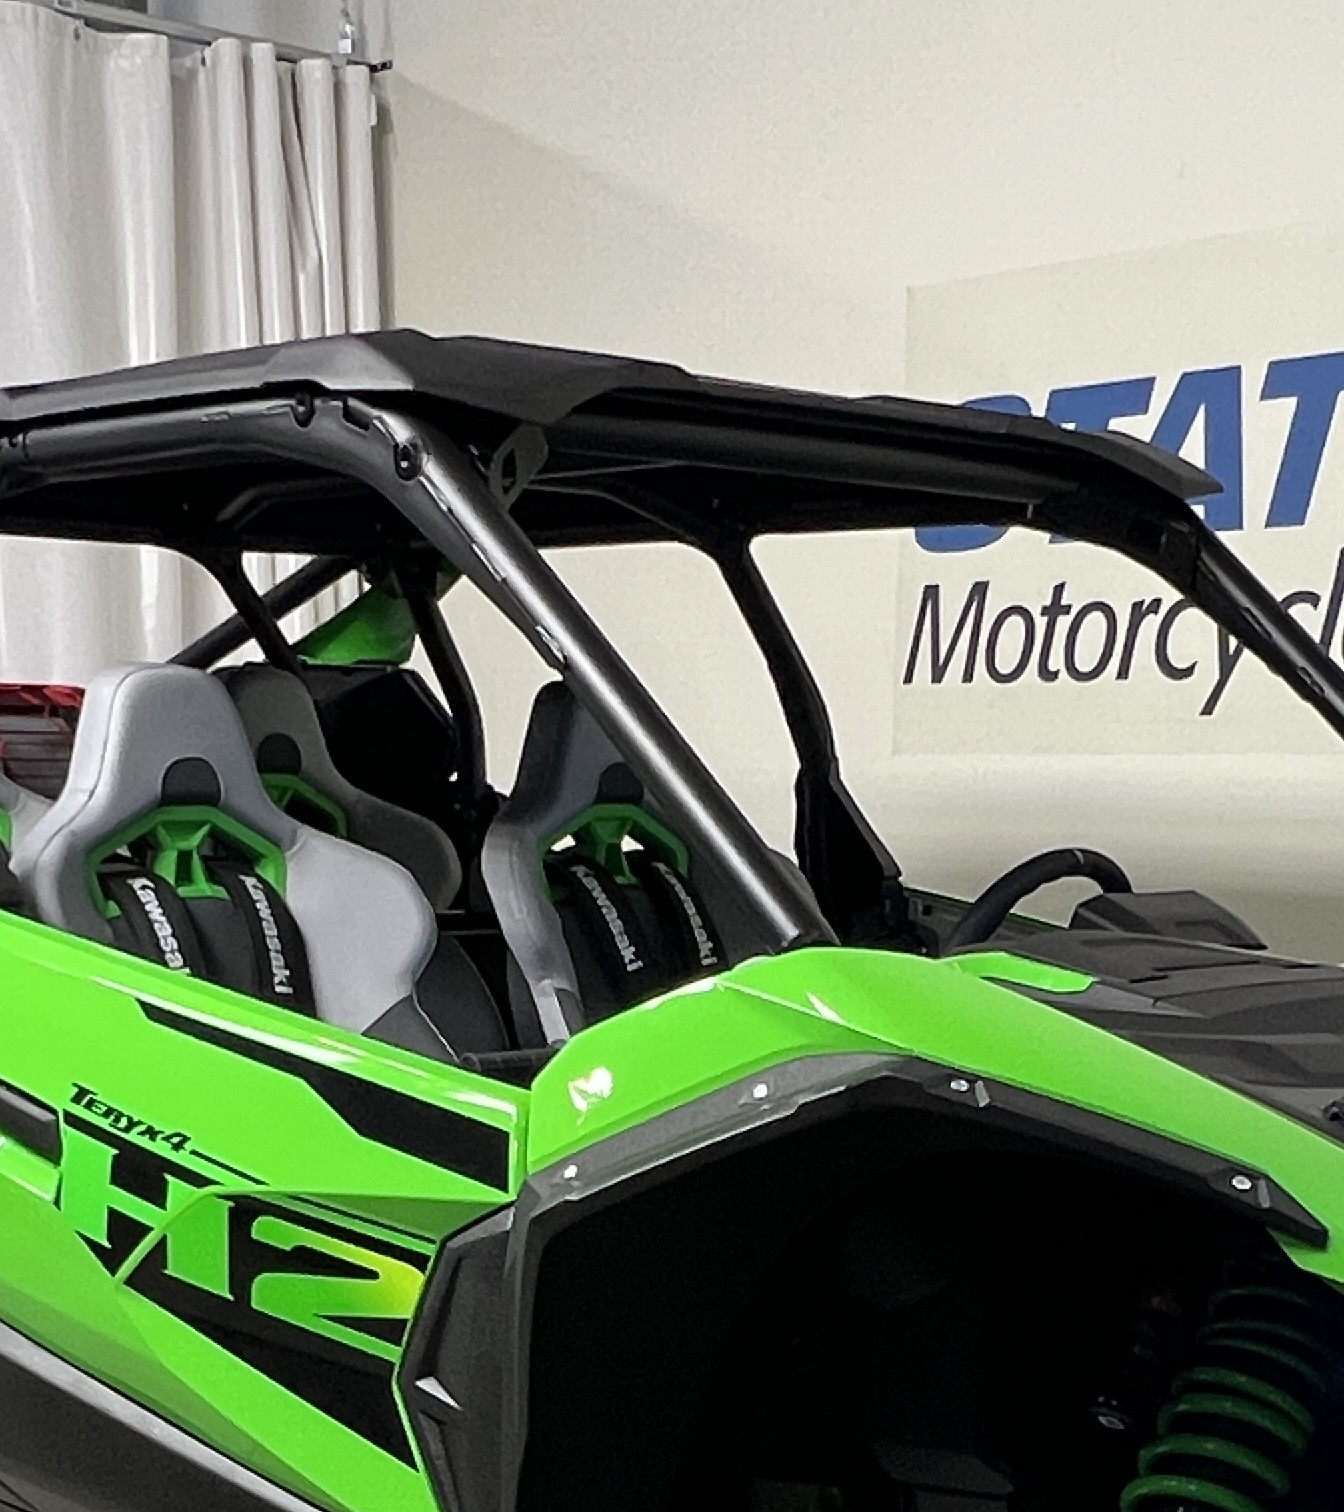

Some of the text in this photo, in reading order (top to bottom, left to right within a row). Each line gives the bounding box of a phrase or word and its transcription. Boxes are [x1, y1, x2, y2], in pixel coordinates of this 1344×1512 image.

[238, 874, 294, 994] Kawasaki
[568, 864, 644, 972] Kawasaki
[60, 1125, 427, 1363] H2
